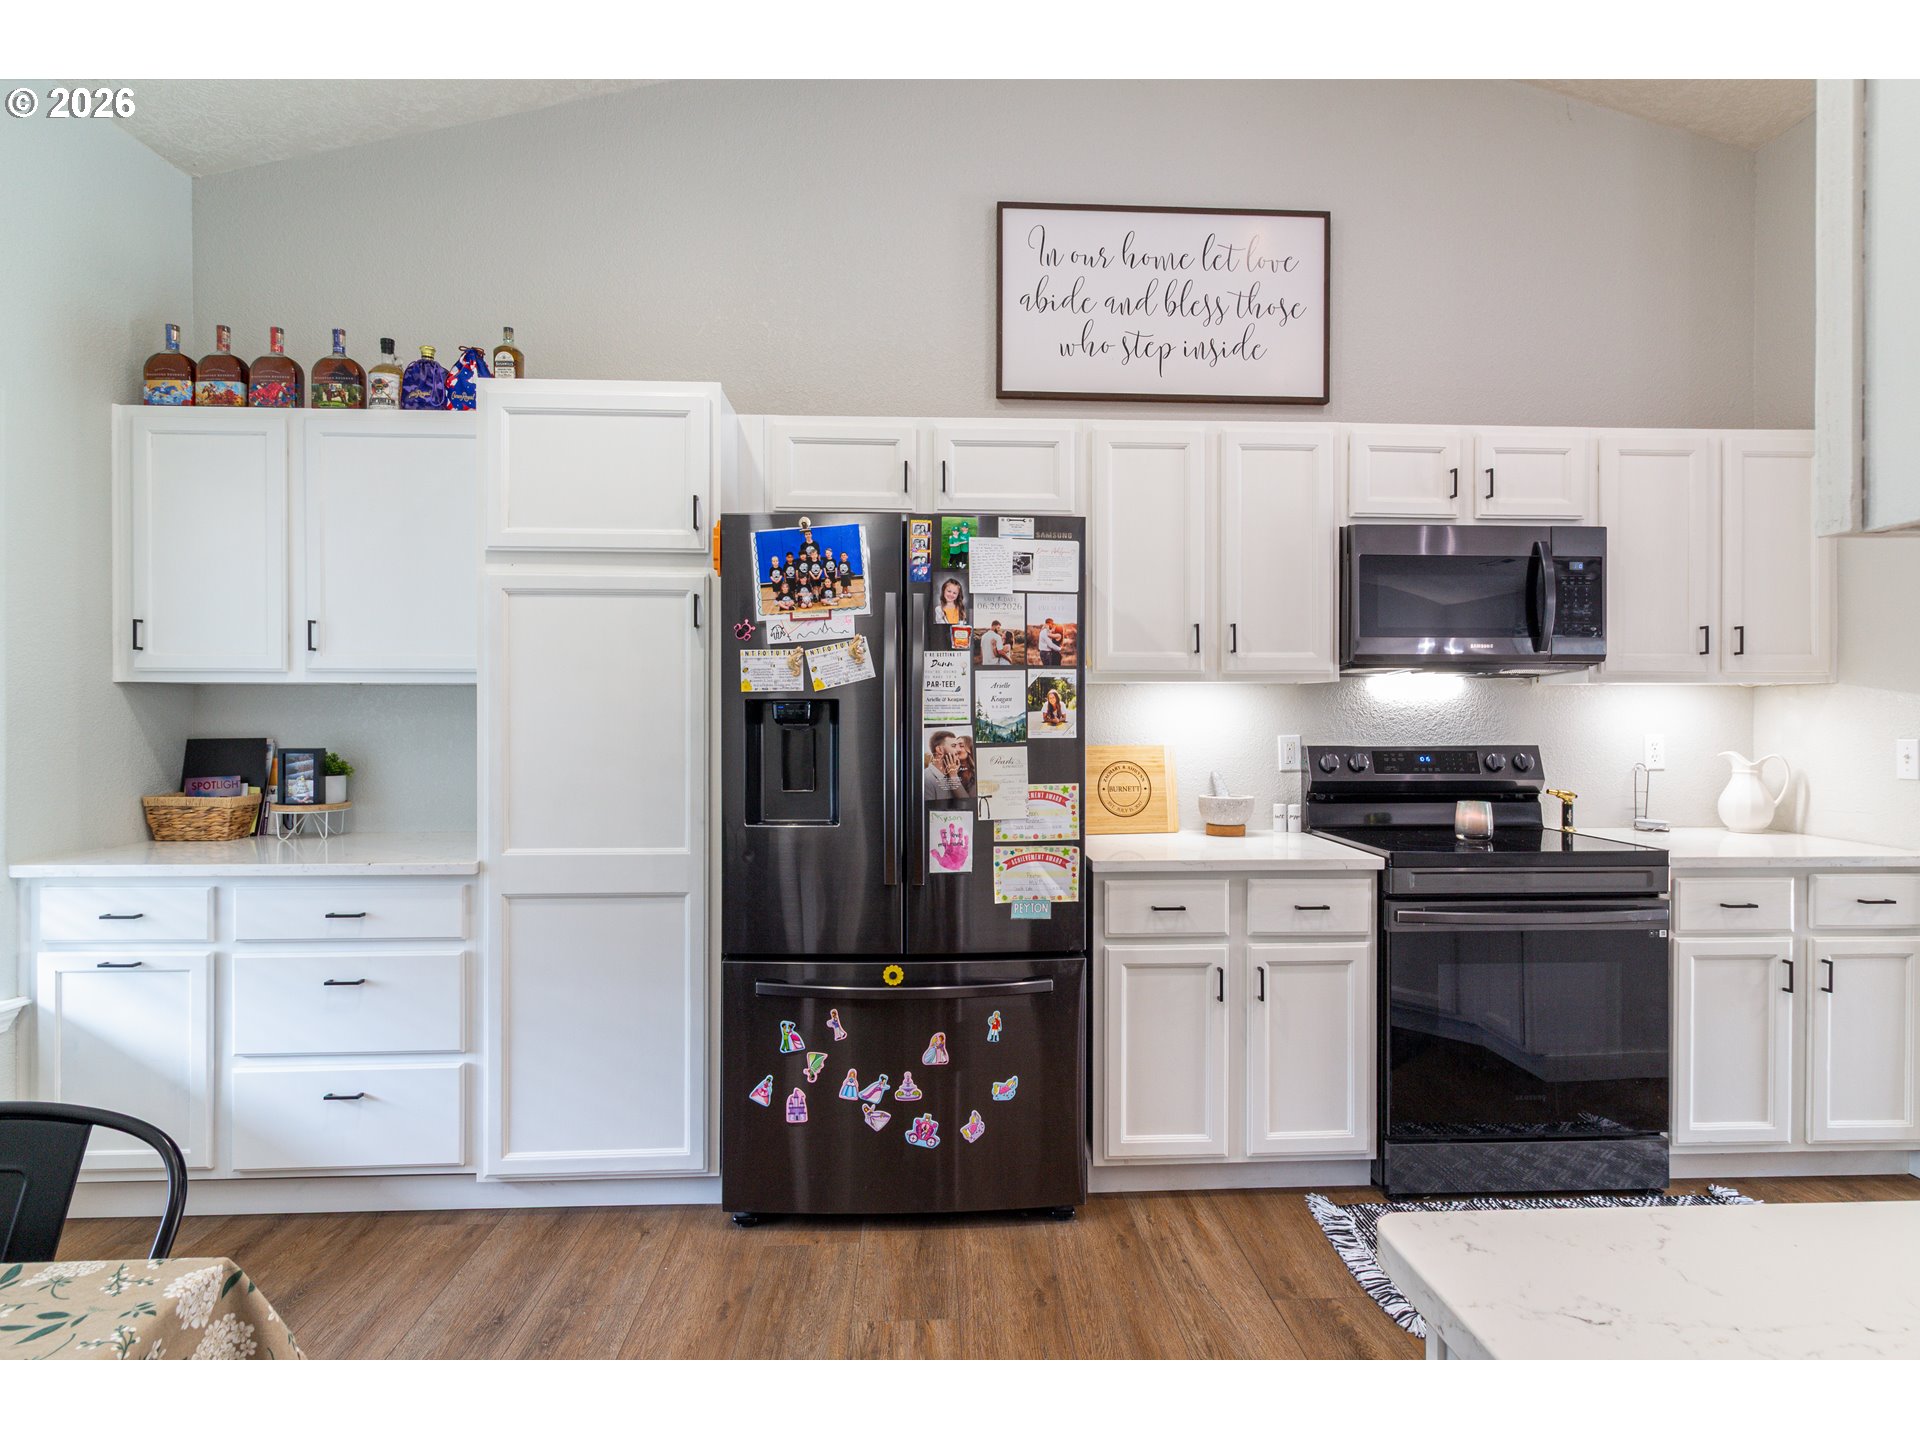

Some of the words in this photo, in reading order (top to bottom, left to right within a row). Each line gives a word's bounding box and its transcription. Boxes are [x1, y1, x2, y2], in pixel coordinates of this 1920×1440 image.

[1028, 225, 1064, 267] In
[1071, 246, 1115, 269] our
[1122, 230, 1195, 271] home
[1202, 233, 1246, 272] let
[1246, 234, 1299, 273] love
[1019, 275, 1097, 315] abide
[1104, 278, 1158, 316] and
[1164, 279, 1229, 327] bless
[1227, 281, 1307, 326] those
[1059, 319, 1115, 357] who
[1121, 330, 1176, 377] step
[1184, 323, 1267, 366] inside
[1035, 531, 1073, 539] SAMSUNG
[191, 780, 240, 791] SPOTLIGH
[1010, 853, 1044, 865] ACHIEVEMENT
[1045, 854, 1063, 865] AWARD
[1014, 903, 1049, 914] PEYTON
